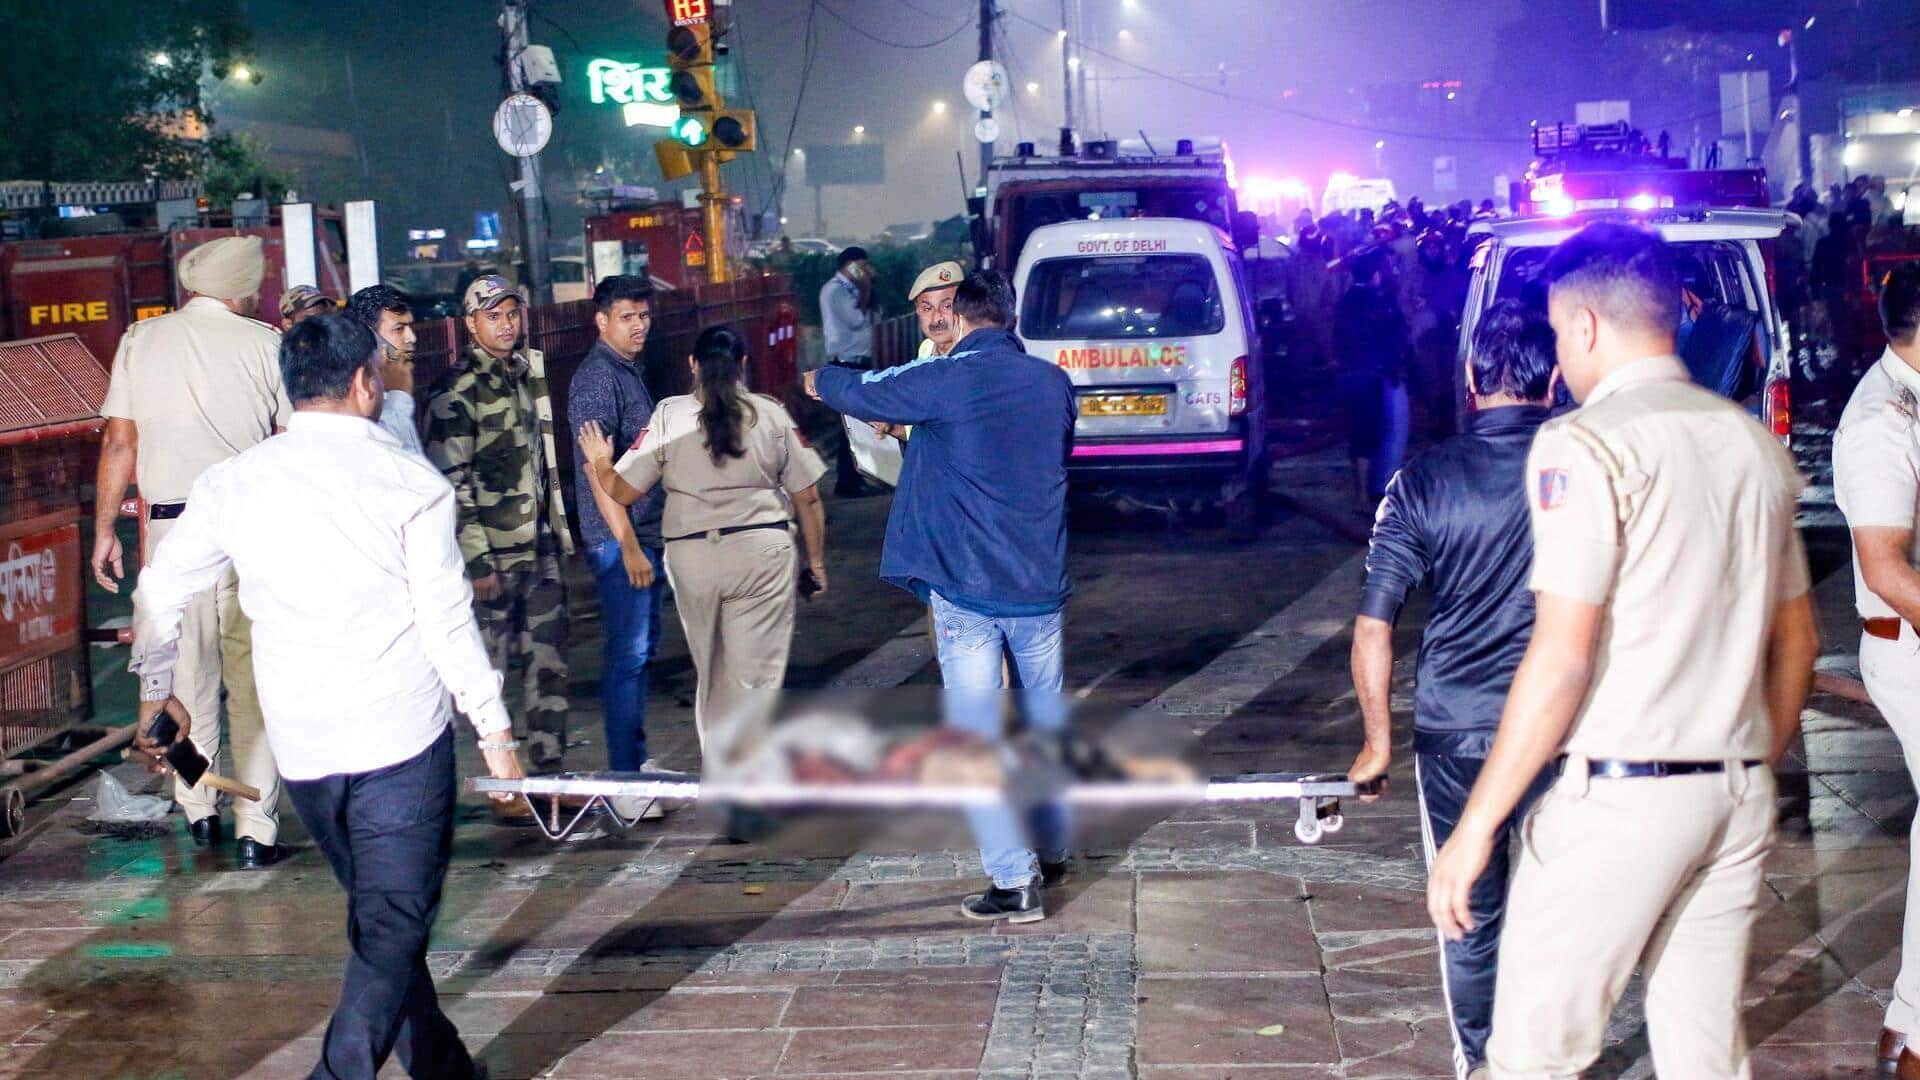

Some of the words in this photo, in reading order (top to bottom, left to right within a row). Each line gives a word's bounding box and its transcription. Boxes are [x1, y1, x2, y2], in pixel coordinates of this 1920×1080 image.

[1077, 241, 1111, 253] GOVT.
[1114, 241, 1129, 252] OF
[1132, 239, 1167, 252] DELHI
[30, 302, 108, 325] FIRE
[1185, 392, 1221, 405] CATS
